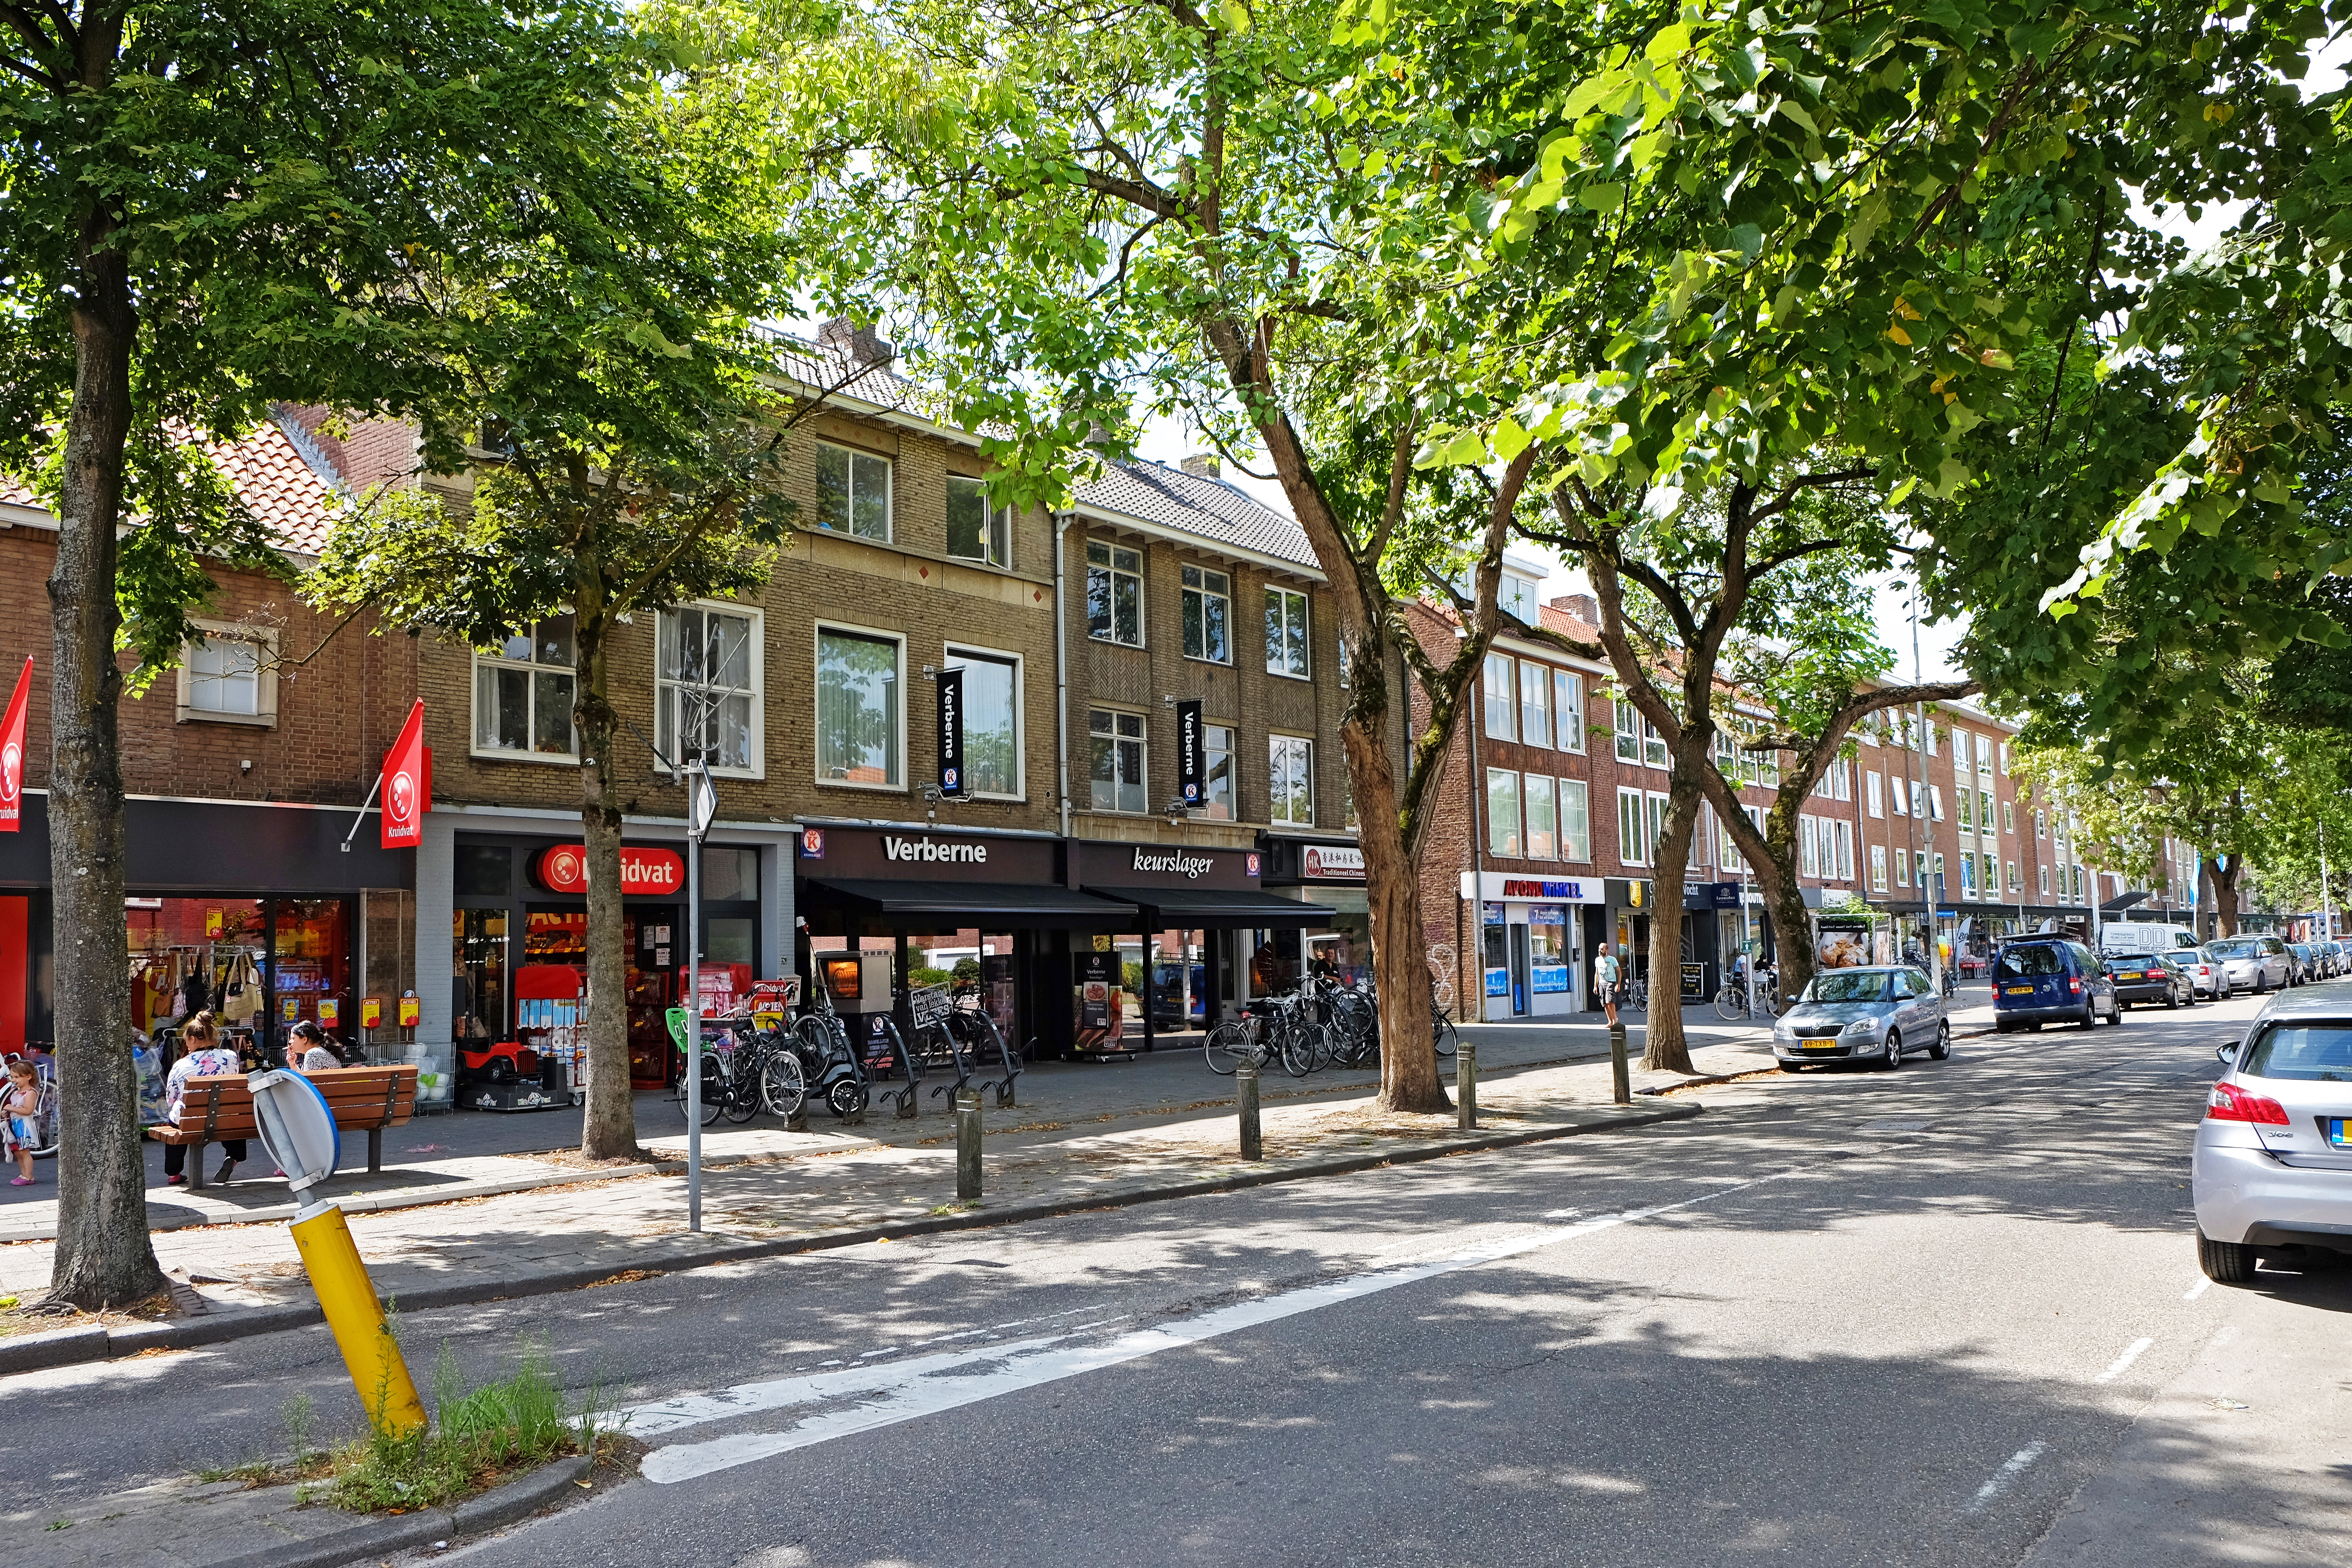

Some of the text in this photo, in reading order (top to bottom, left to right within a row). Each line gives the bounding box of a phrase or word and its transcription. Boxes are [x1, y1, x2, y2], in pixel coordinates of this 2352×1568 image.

[944, 684, 955, 759] Verberne
[1185, 711, 1195, 775] Verberne
[947, 773, 954, 783] K
[388, 824, 413, 837] Kruidvat
[807, 836, 818, 849] K
[885, 836, 987, 863] Verberne
[583, 857, 673, 883] idvat
[1134, 846, 1213, 879] keurslager
[1250, 859, 1257, 870] K
[1308, 855, 1320, 870] HK
[1534, 909, 1539, 920] 7
[2139, 927, 2165, 946] DD
[916, 997, 948, 1012] van lekke
[2267, 1130, 2294, 1138] 308
